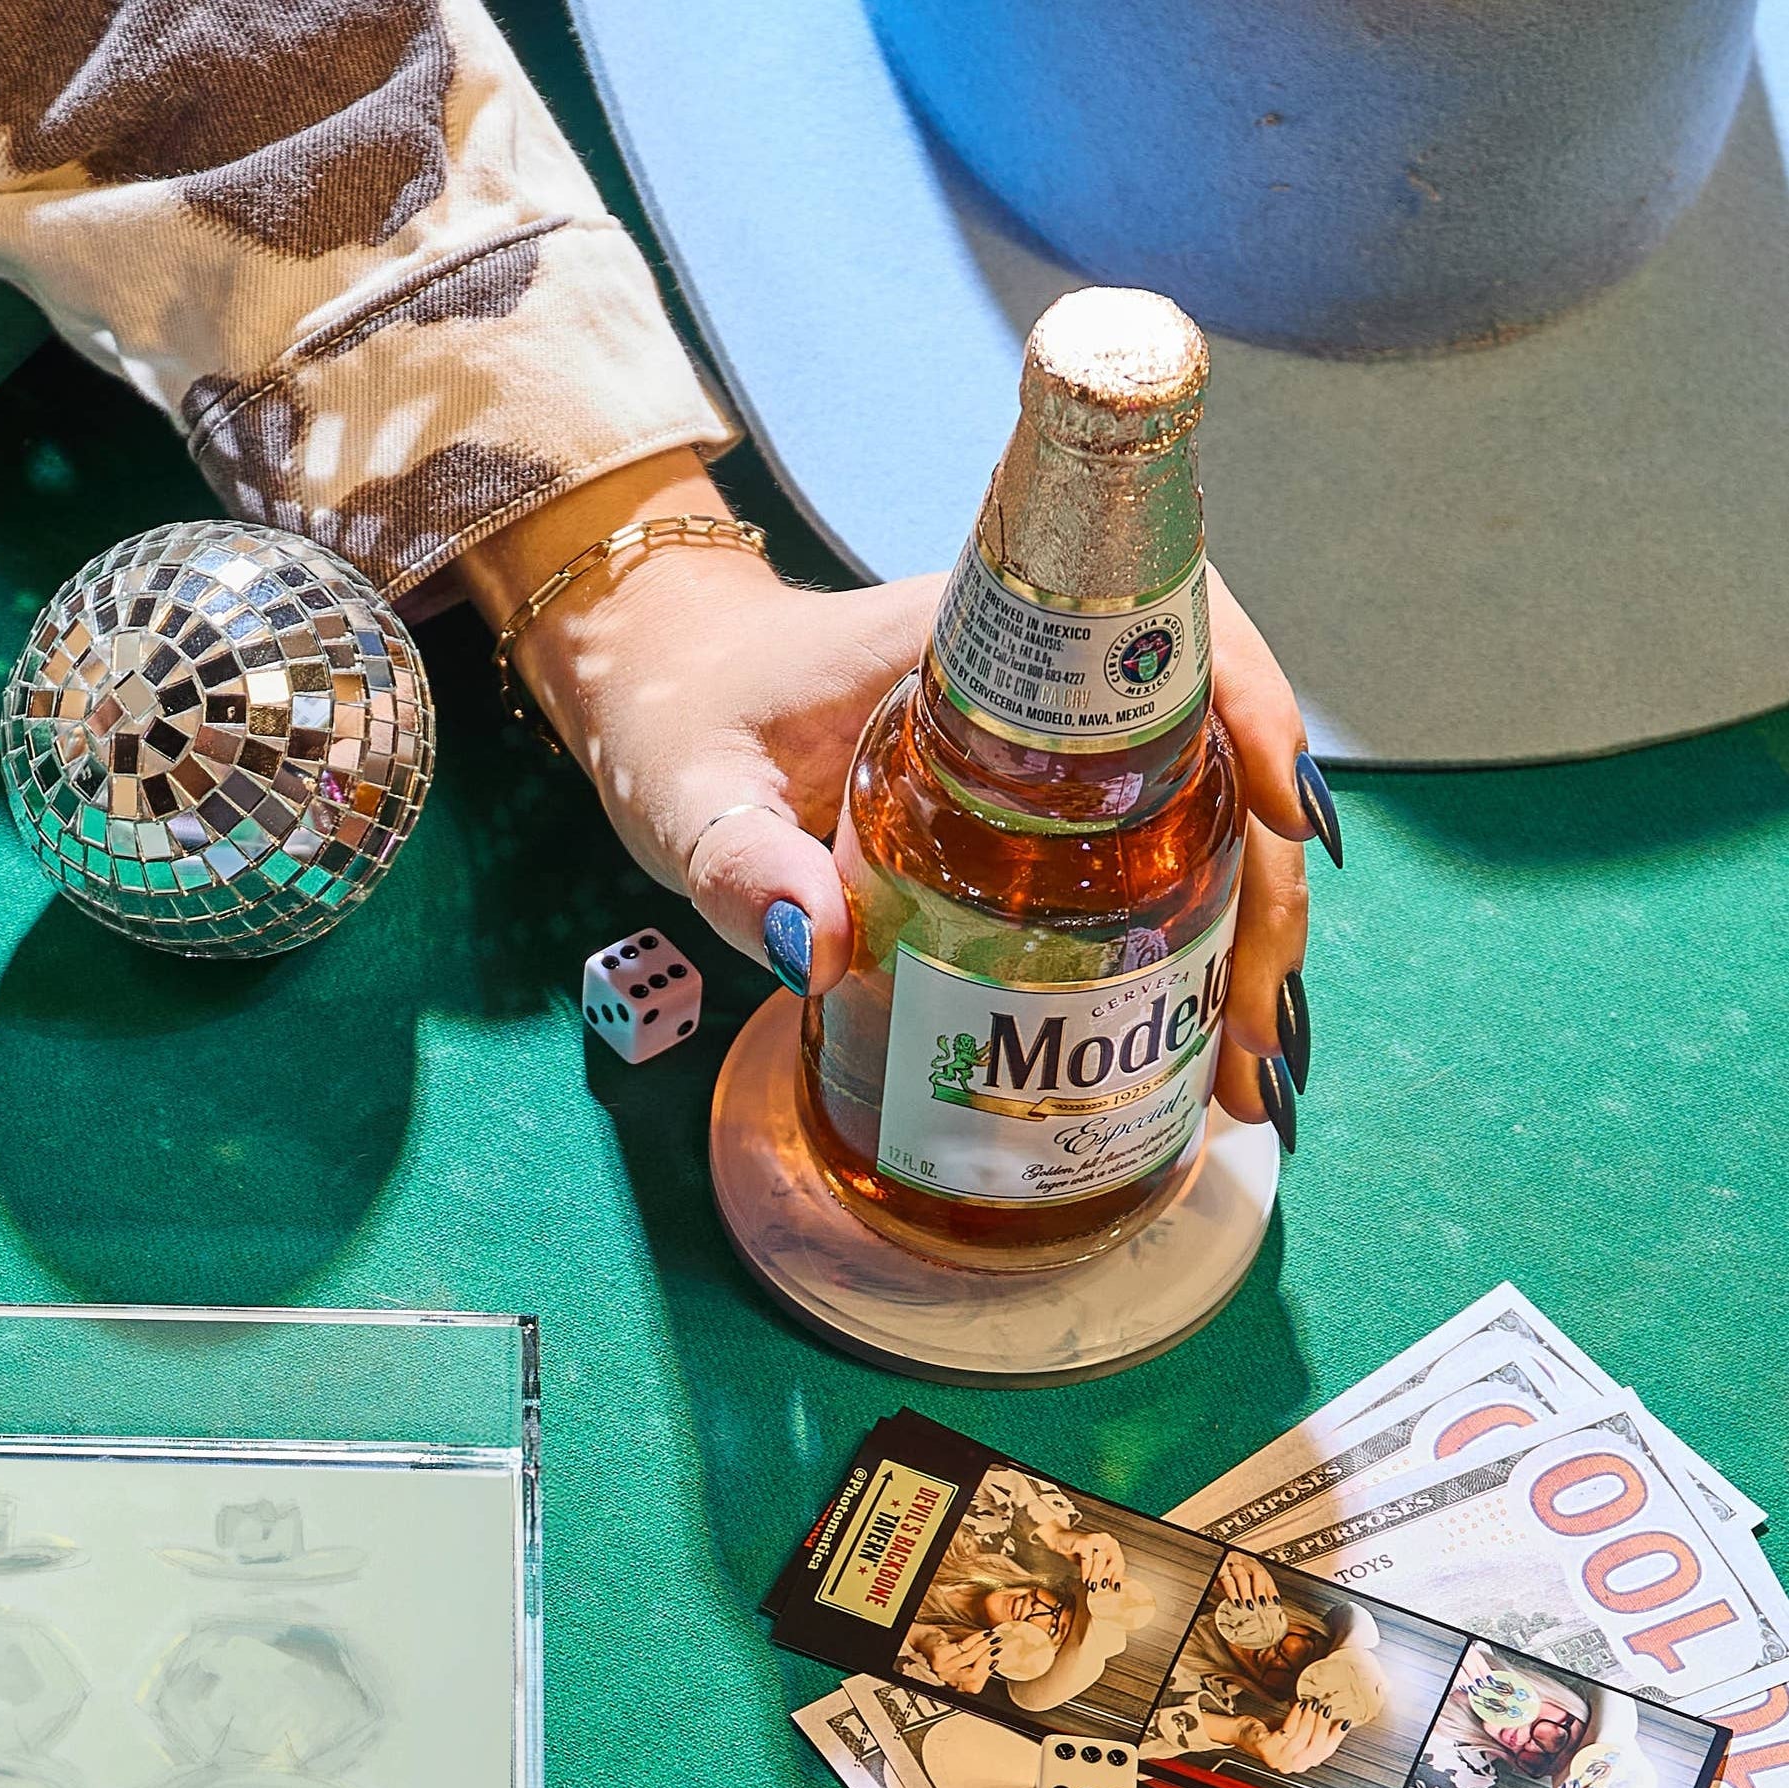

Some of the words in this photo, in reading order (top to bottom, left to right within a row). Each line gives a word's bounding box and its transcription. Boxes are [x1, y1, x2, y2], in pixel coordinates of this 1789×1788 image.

[976, 615, 999, 643] PROTEIN
[1020, 646, 1033, 661] FAT
[985, 587, 1024, 625] BREWED
[1026, 616, 1039, 632] IN
[1043, 622, 1091, 641] MEXICO
[993, 613, 1023, 639] AVERAGE
[1024, 631, 1064, 652] ANALYSIS:
[992, 646, 1026, 673] Call/Text
[1028, 665, 1086, 685] 800-683-4227
[1108, 619, 1158, 683] CERVECERIA
[1163, 616, 1183, 659] MODELO
[957, 664, 969, 681] BY
[969, 674, 1023, 716] CERVECERIA
[1026, 706, 1075, 727] MODELO,
[1116, 701, 1155, 723] MEXICO
[1040, 684, 1057, 707] CA
[1064, 689, 1091, 709] CRV
[1124, 670, 1171, 695] MEXICO
[982, 947, 1233, 1091] Modelo
[1091, 971, 1190, 1018] CERVEZA
[1054, 1079, 1187, 1156] Especial
[1113, 1085, 1150, 1105] 1925
[889, 1146, 900, 1162] 12
[903, 1152, 917, 1171] FL.
[921, 1160, 937, 1179] OZ.
[1035, 1180, 1069, 1194] lager
[1070, 1170, 1094, 1185] with
[1097, 1170, 1106, 1178] a
[807, 1467, 868, 1570] @Photomatica
[901, 1486, 941, 1536] DEVIL'S
[1219, 1463, 1344, 1537] PURPOSES
[1301, 1494, 1435, 1555] PURPOSES
[858, 1511, 901, 1563] TAVERN
[865, 1534, 917, 1609] BACKBONE
[1334, 1554, 1394, 1584] TOYS
[1529, 1452, 1740, 1674] 100
